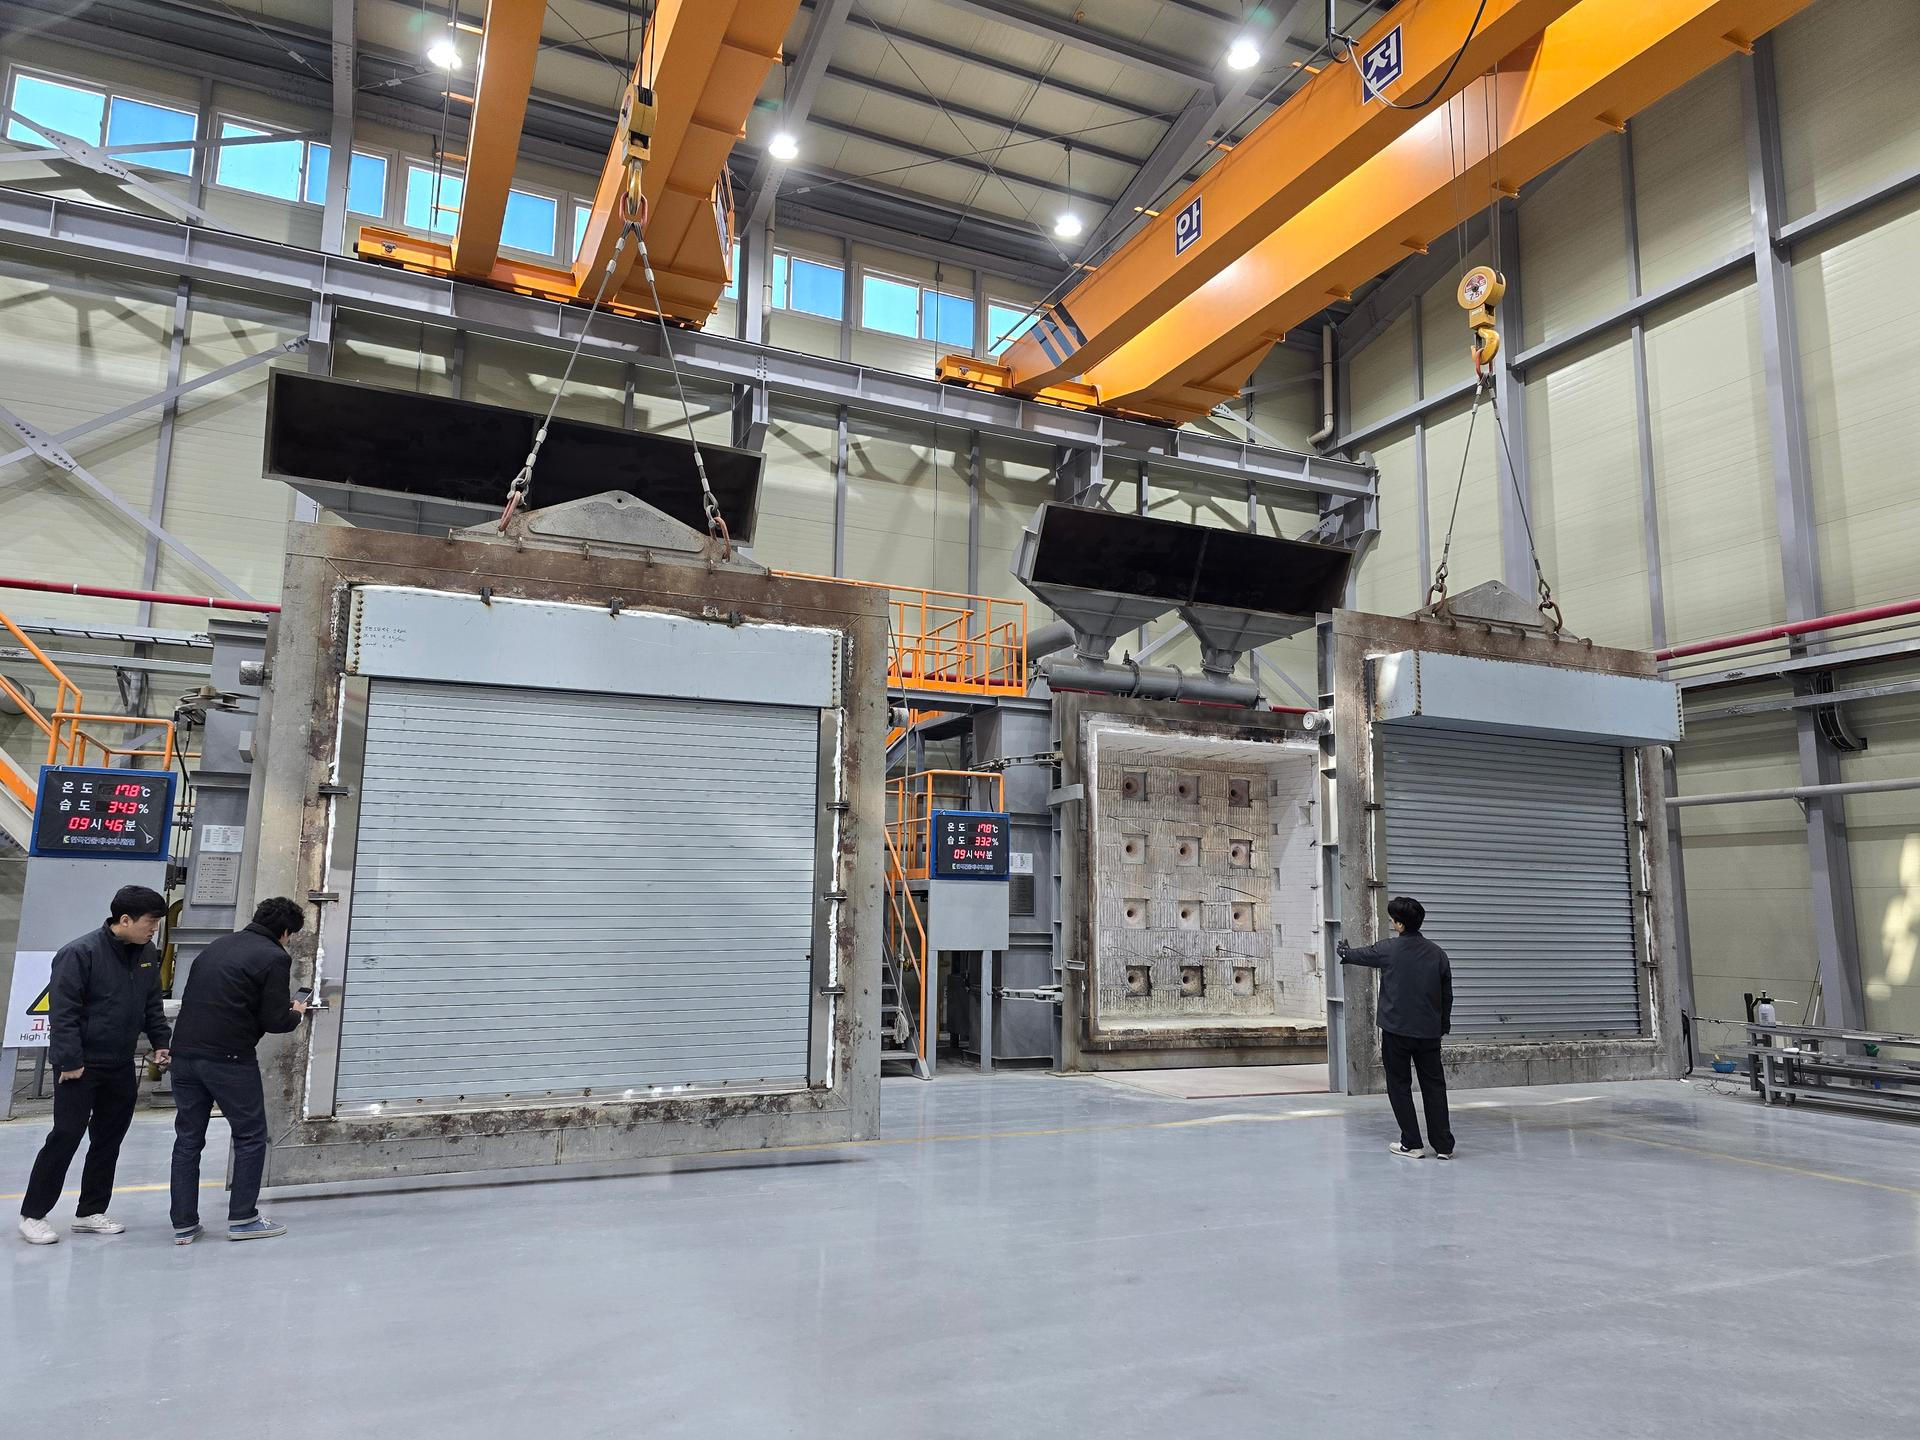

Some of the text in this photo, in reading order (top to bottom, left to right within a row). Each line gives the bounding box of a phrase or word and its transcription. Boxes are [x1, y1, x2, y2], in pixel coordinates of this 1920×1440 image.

[1177, 32, 1399, 251] 안 전
[20, 1033, 41, 1041] High
